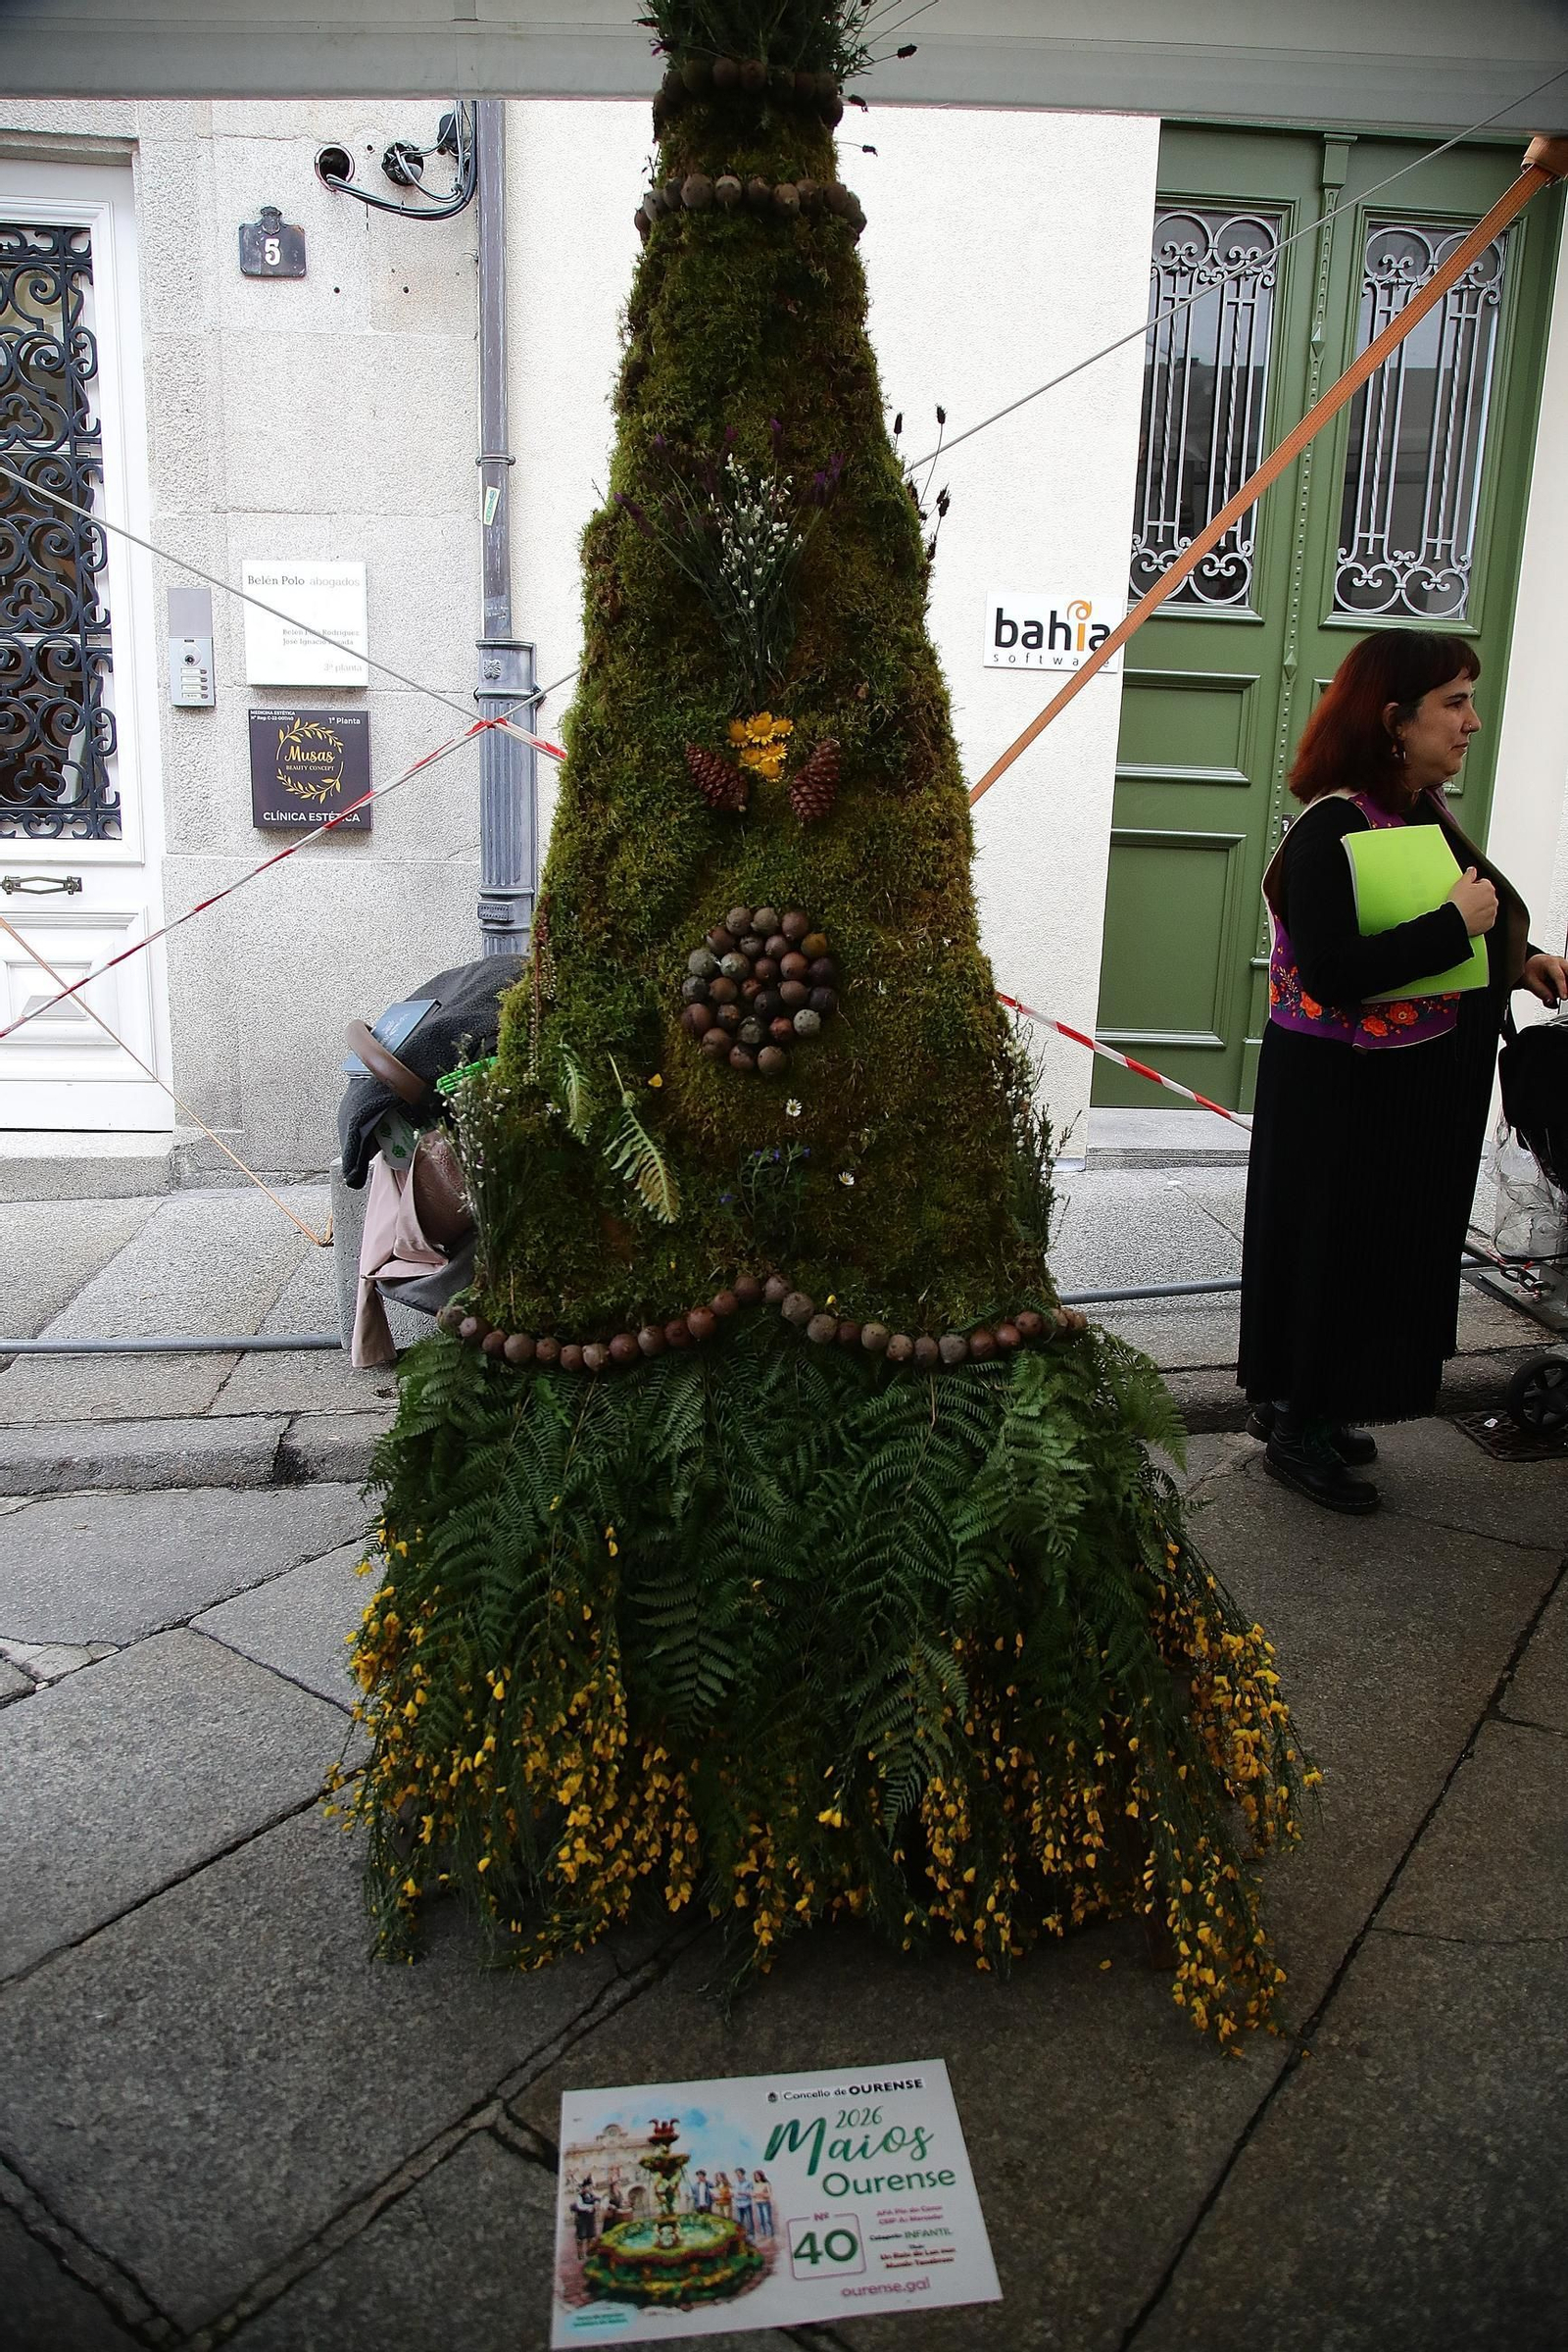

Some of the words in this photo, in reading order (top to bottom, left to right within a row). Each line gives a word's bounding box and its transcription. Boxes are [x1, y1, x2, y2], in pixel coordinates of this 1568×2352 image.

[264, 237, 282, 267] 5
[247, 575, 278, 585] Belén
[281, 575, 306, 585] Polo
[309, 577, 361, 588] abogados
[993, 653, 1109, 667] softwae
[284, 745, 336, 763] Musas
[263, 810, 307, 822] CLÍNICA
[784, 2089, 830, 2101] Concello
[834, 2088, 847, 2097] de
[849, 2079, 923, 2095] OURENSE
[835, 2106, 884, 2130] 2026
[763, 2116, 934, 2177] Maios
[822, 2168, 956, 2197] Ourense
[905, 2228, 953, 2238] INFANTIL
[793, 2229, 858, 2265] 40
[841, 2278, 930, 2297] ourense.gal
